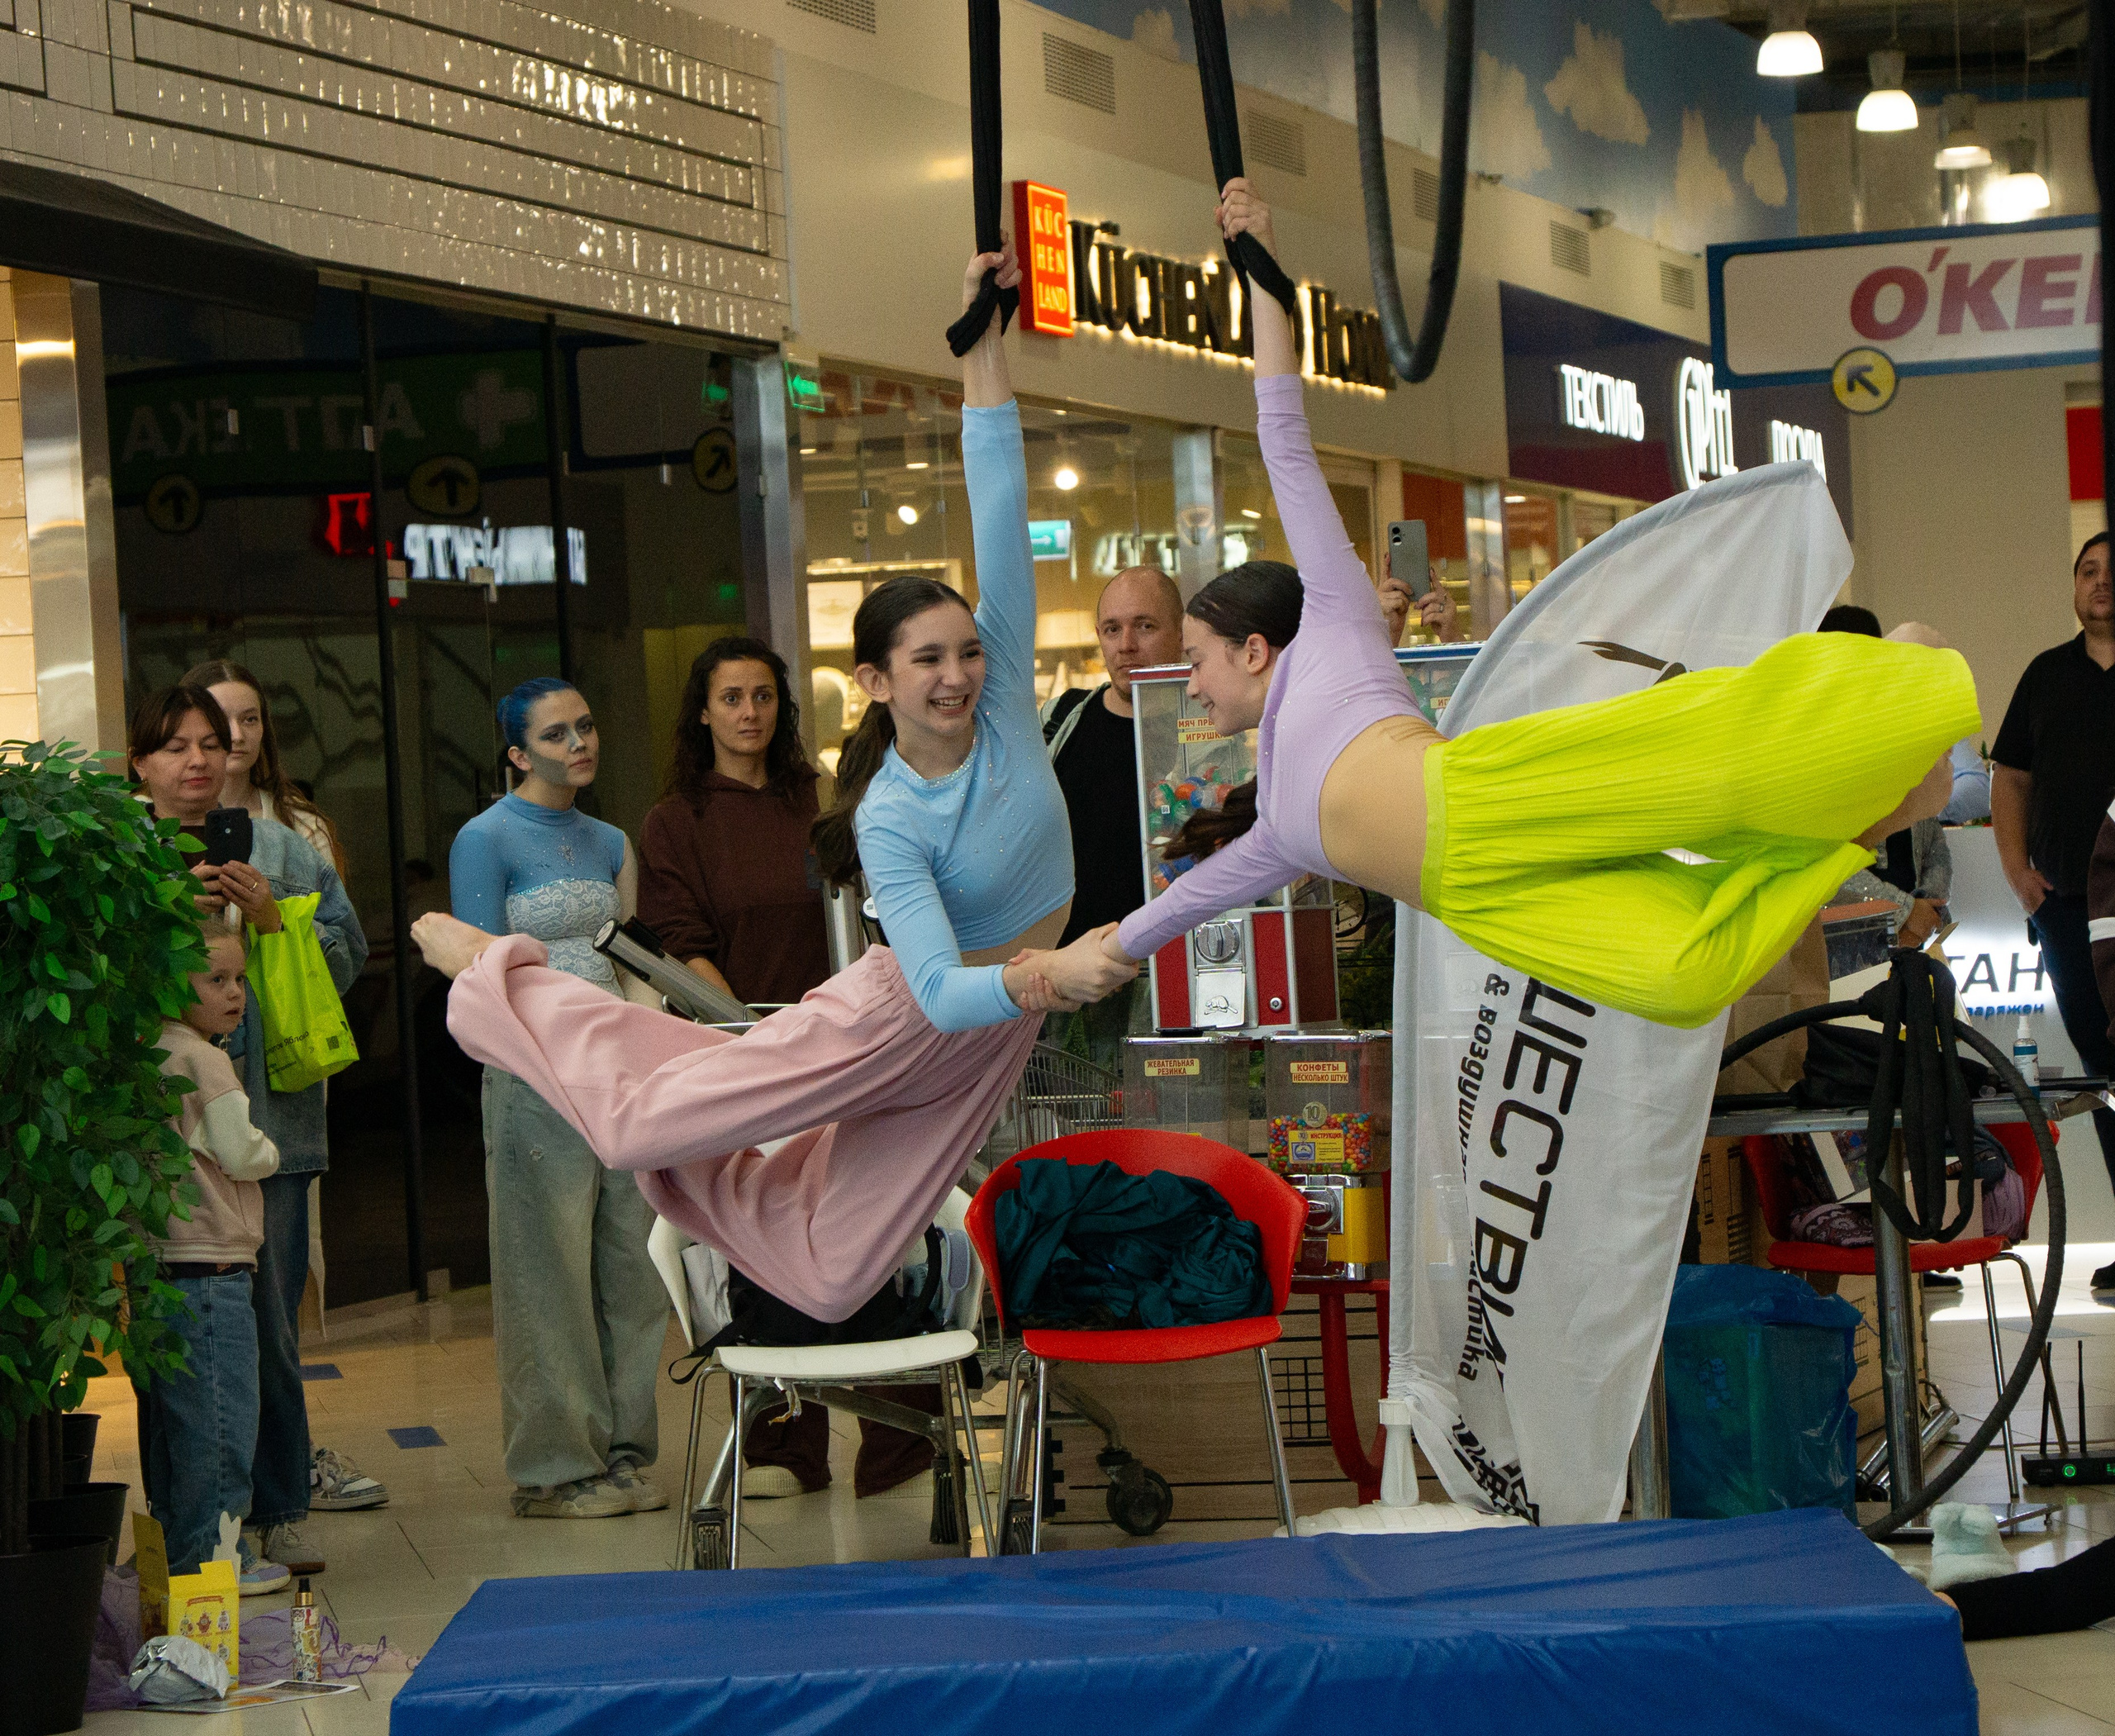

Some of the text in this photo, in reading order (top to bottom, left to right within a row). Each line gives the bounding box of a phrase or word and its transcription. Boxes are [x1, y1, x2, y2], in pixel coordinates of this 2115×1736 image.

[1034, 203, 1063, 238] KÜC
[1036, 243, 1066, 274] HEN
[1038, 282, 1067, 313] LAND
[1561, 364, 1645, 441] ТЕКСТИЛЬ
[1484, 973, 1510, 996] &
[1147, 1059, 1195, 1068] ЖЕВАТЕЛЬНАЯ
[1157, 1068, 1187, 1076] РЕЗИНКА
[1297, 1063, 1339, 1072] КОНФЕТЫ
[1305, 1106, 1320, 1120] 10
